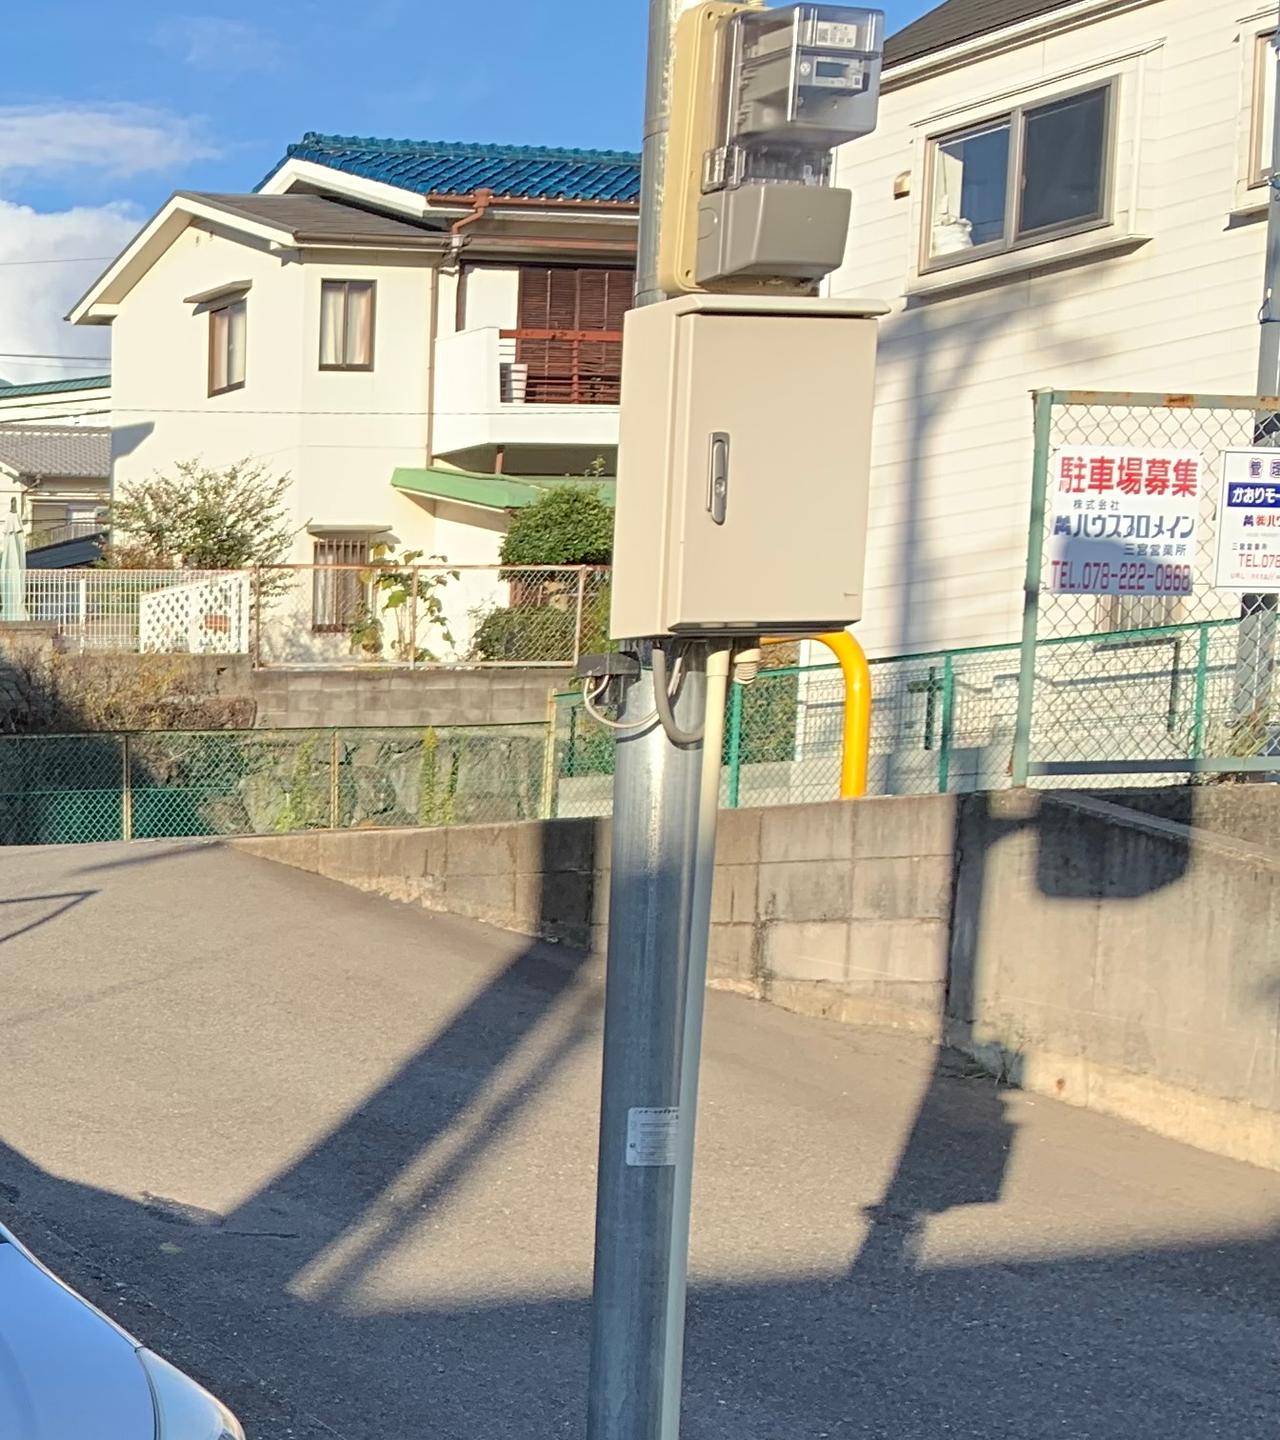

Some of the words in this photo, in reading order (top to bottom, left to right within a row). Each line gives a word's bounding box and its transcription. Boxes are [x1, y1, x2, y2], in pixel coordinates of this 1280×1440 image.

[1059, 456, 1198, 497] 駐車場募集
[1073, 499, 1120, 511] 株式会社
[1072, 514, 1195, 538] ハウスプロメイン
[1123, 543, 1187, 557] 三宮営業所
